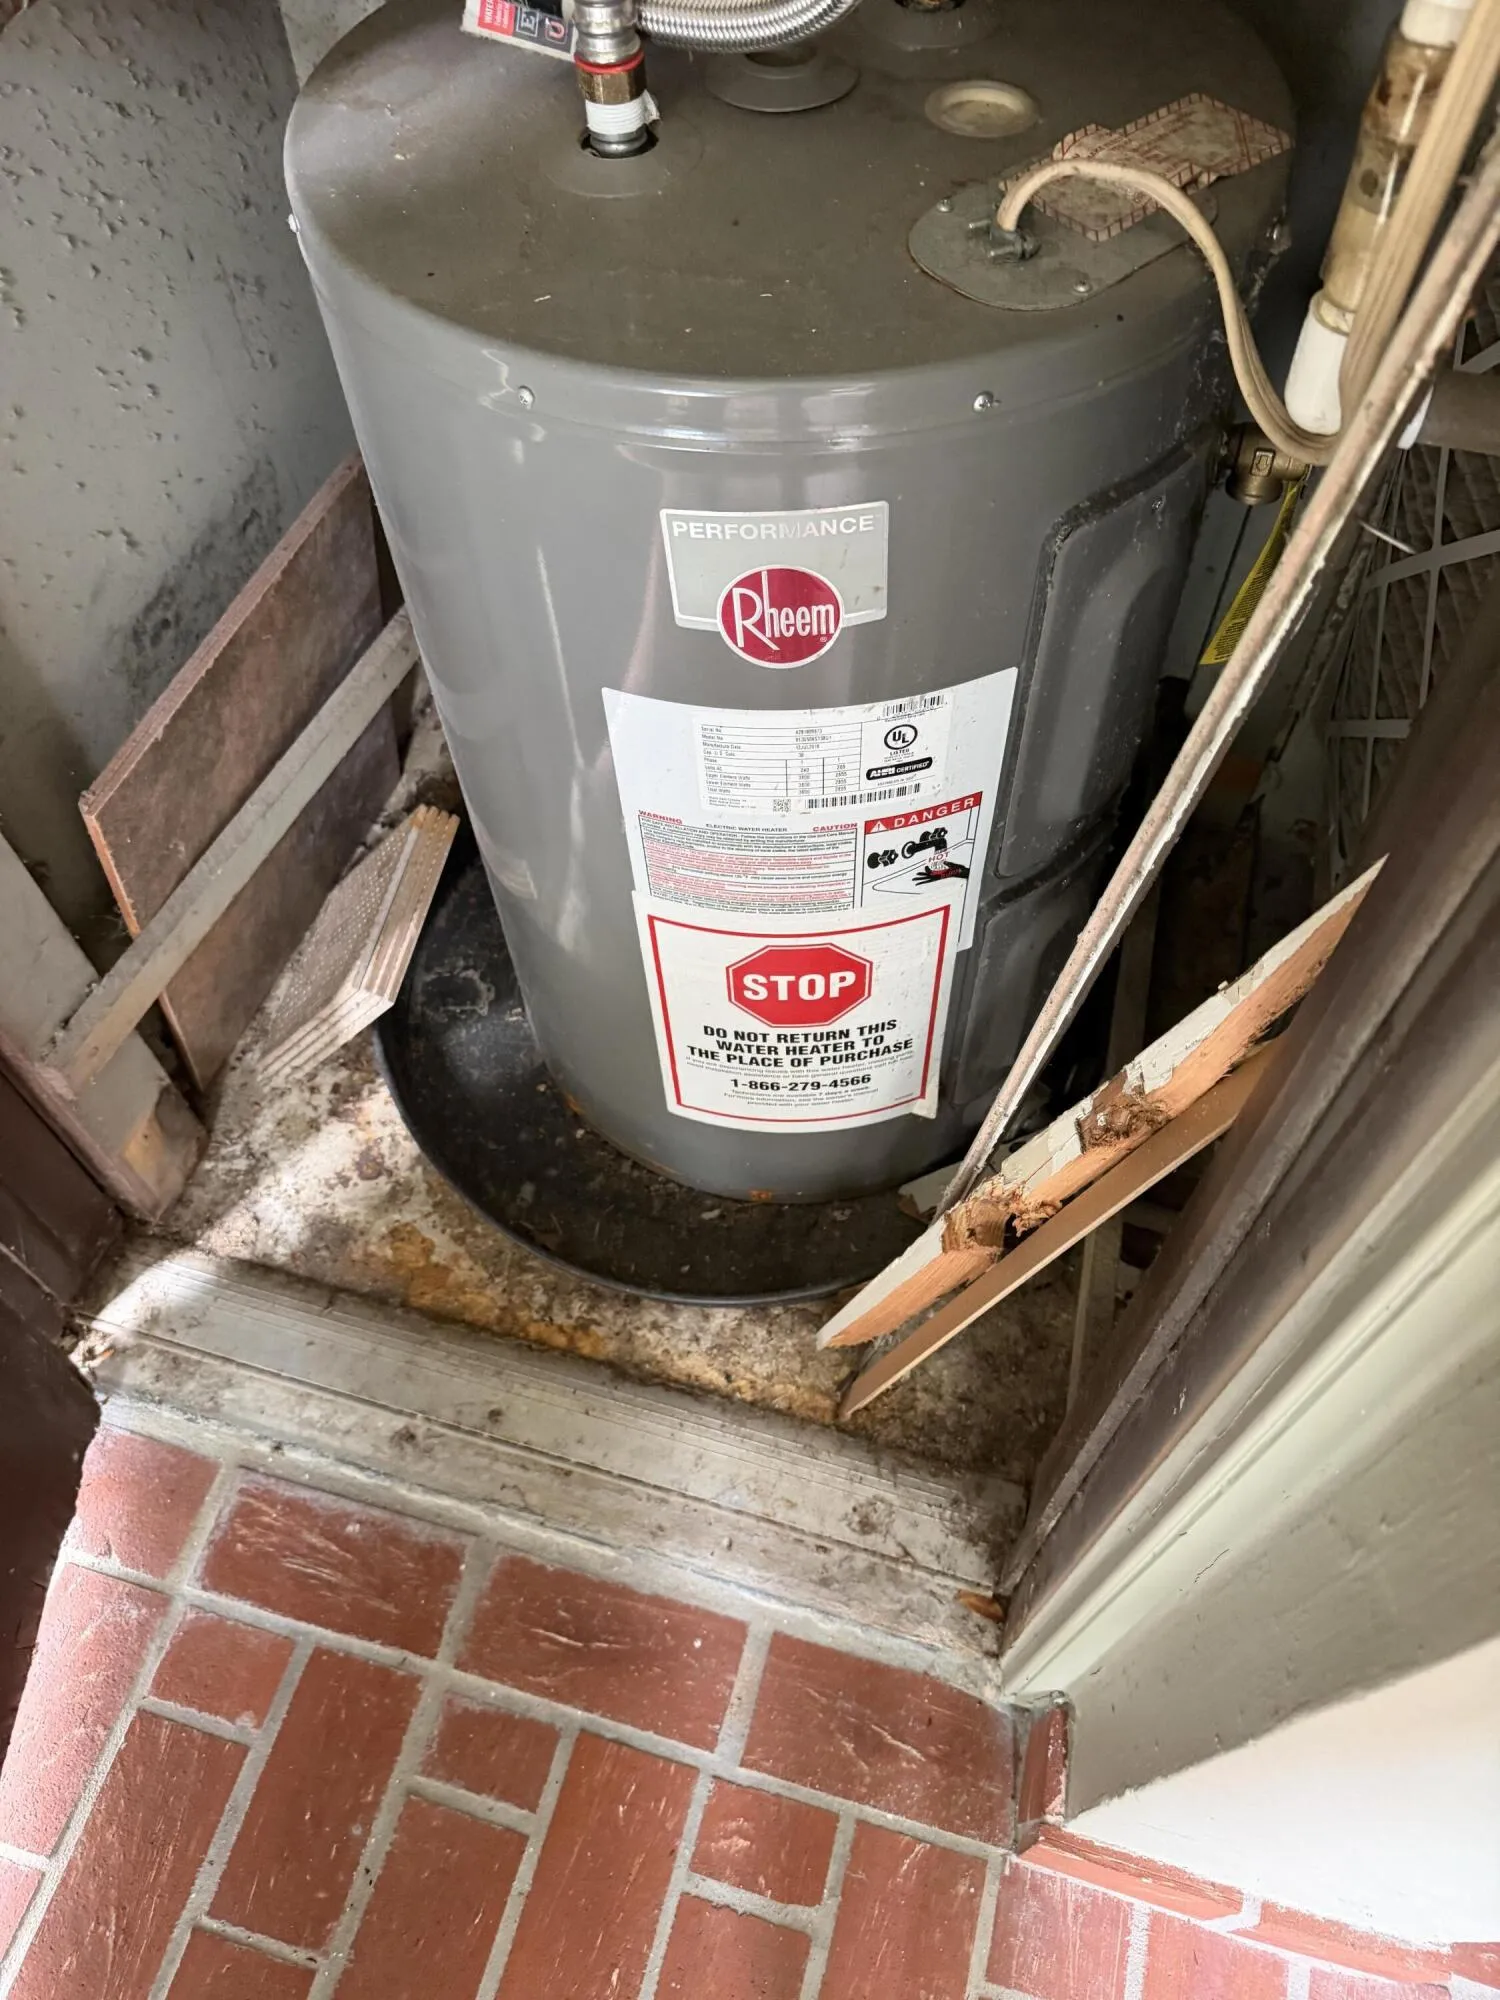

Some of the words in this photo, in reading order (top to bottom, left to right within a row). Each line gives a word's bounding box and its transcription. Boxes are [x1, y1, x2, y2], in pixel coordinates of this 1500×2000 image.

[672, 515, 874, 540] PERFORMANCE
[732, 570, 835, 650] Rheem
[638, 810, 682, 825] WARNING
[894, 798, 974, 827] DANGER
[813, 823, 858, 832] CAUTION
[928, 852, 949, 863] HOT
[743, 971, 856, 1001] STOP
[703, 1025, 728, 1039] DO
[734, 1030, 770, 1043] NOT
[777, 1028, 850, 1043] RETURN
[857, 1019, 897, 1037] THIS
[687, 1045, 721, 1061] THE
[727, 1054, 784, 1067] PLACE
[791, 1057, 814, 1067] OF
[820, 1038, 913, 1066] PURCHASE
[716, 1040, 779, 1056] WATER
[785, 1040, 855, 1055] HEATER
[862, 1034, 884, 1047] TO
[731, 1074, 871, 1091] 1-866-279-4566
